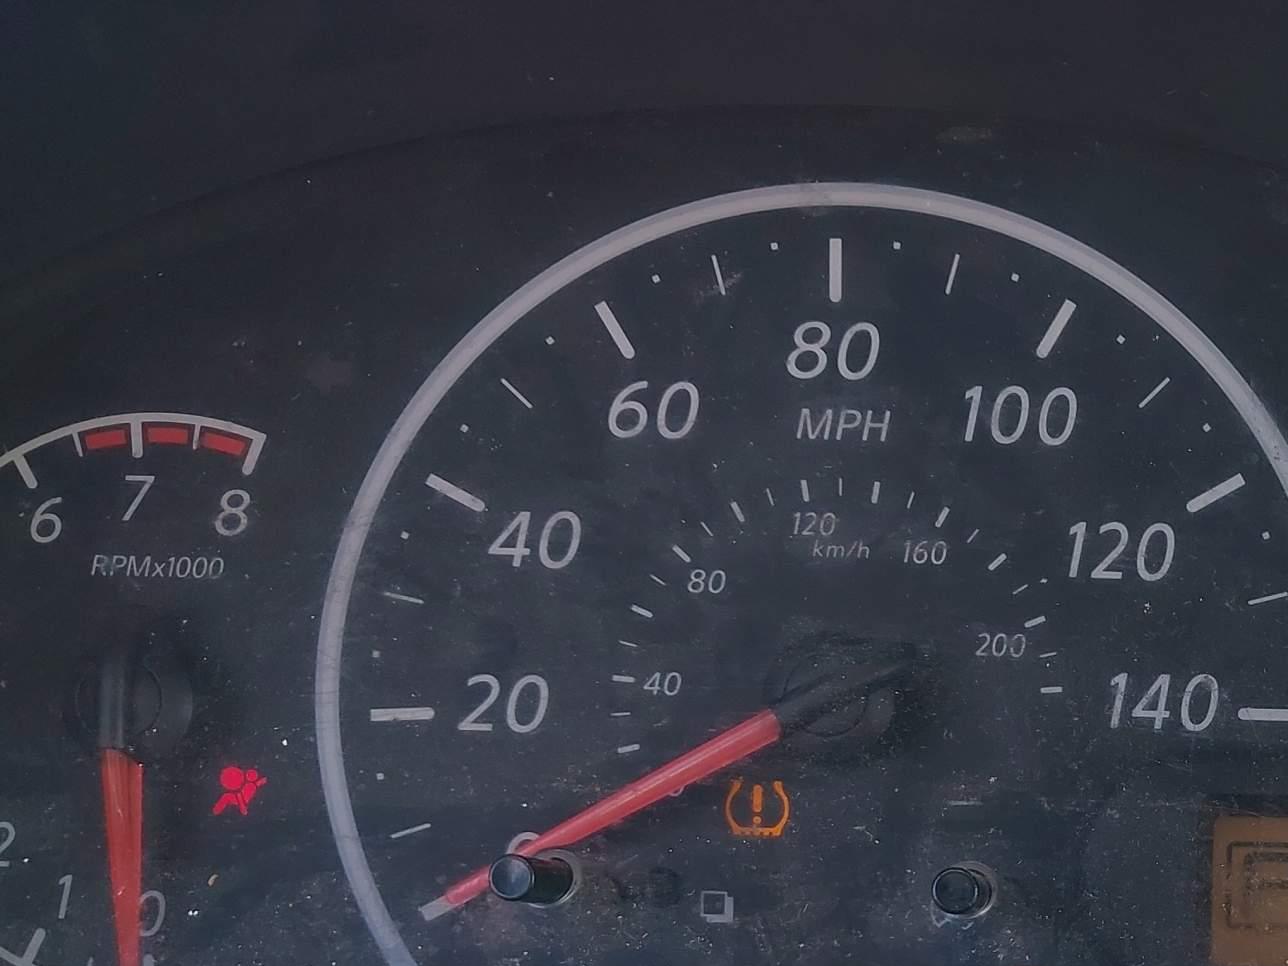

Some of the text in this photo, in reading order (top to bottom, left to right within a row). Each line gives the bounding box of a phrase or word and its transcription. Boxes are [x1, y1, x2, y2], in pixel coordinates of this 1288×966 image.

[786, 321, 880, 380] 80
[607, 380, 700, 440] 60
[797, 408, 891, 442] MPH
[963, 385, 1078, 446] 100
[30, 497, 63, 543] 6
[122, 475, 155, 521] 7
[214, 489, 250, 536] 8
[488, 511, 581, 569] 40
[793, 512, 837, 536] 120
[90, 554, 225, 580] RPMx1000
[812, 541, 870, 560] km/h
[903, 540, 948, 565] 160
[1068, 522, 1176, 582] 120
[687, 569, 726, 593] 80
[975, 632, 1027, 658] 200
[457, 674, 549, 733] 20
[643, 671, 682, 696] 40
[1110, 673, 1219, 732] 140
[58, 874, 73, 919] 1
